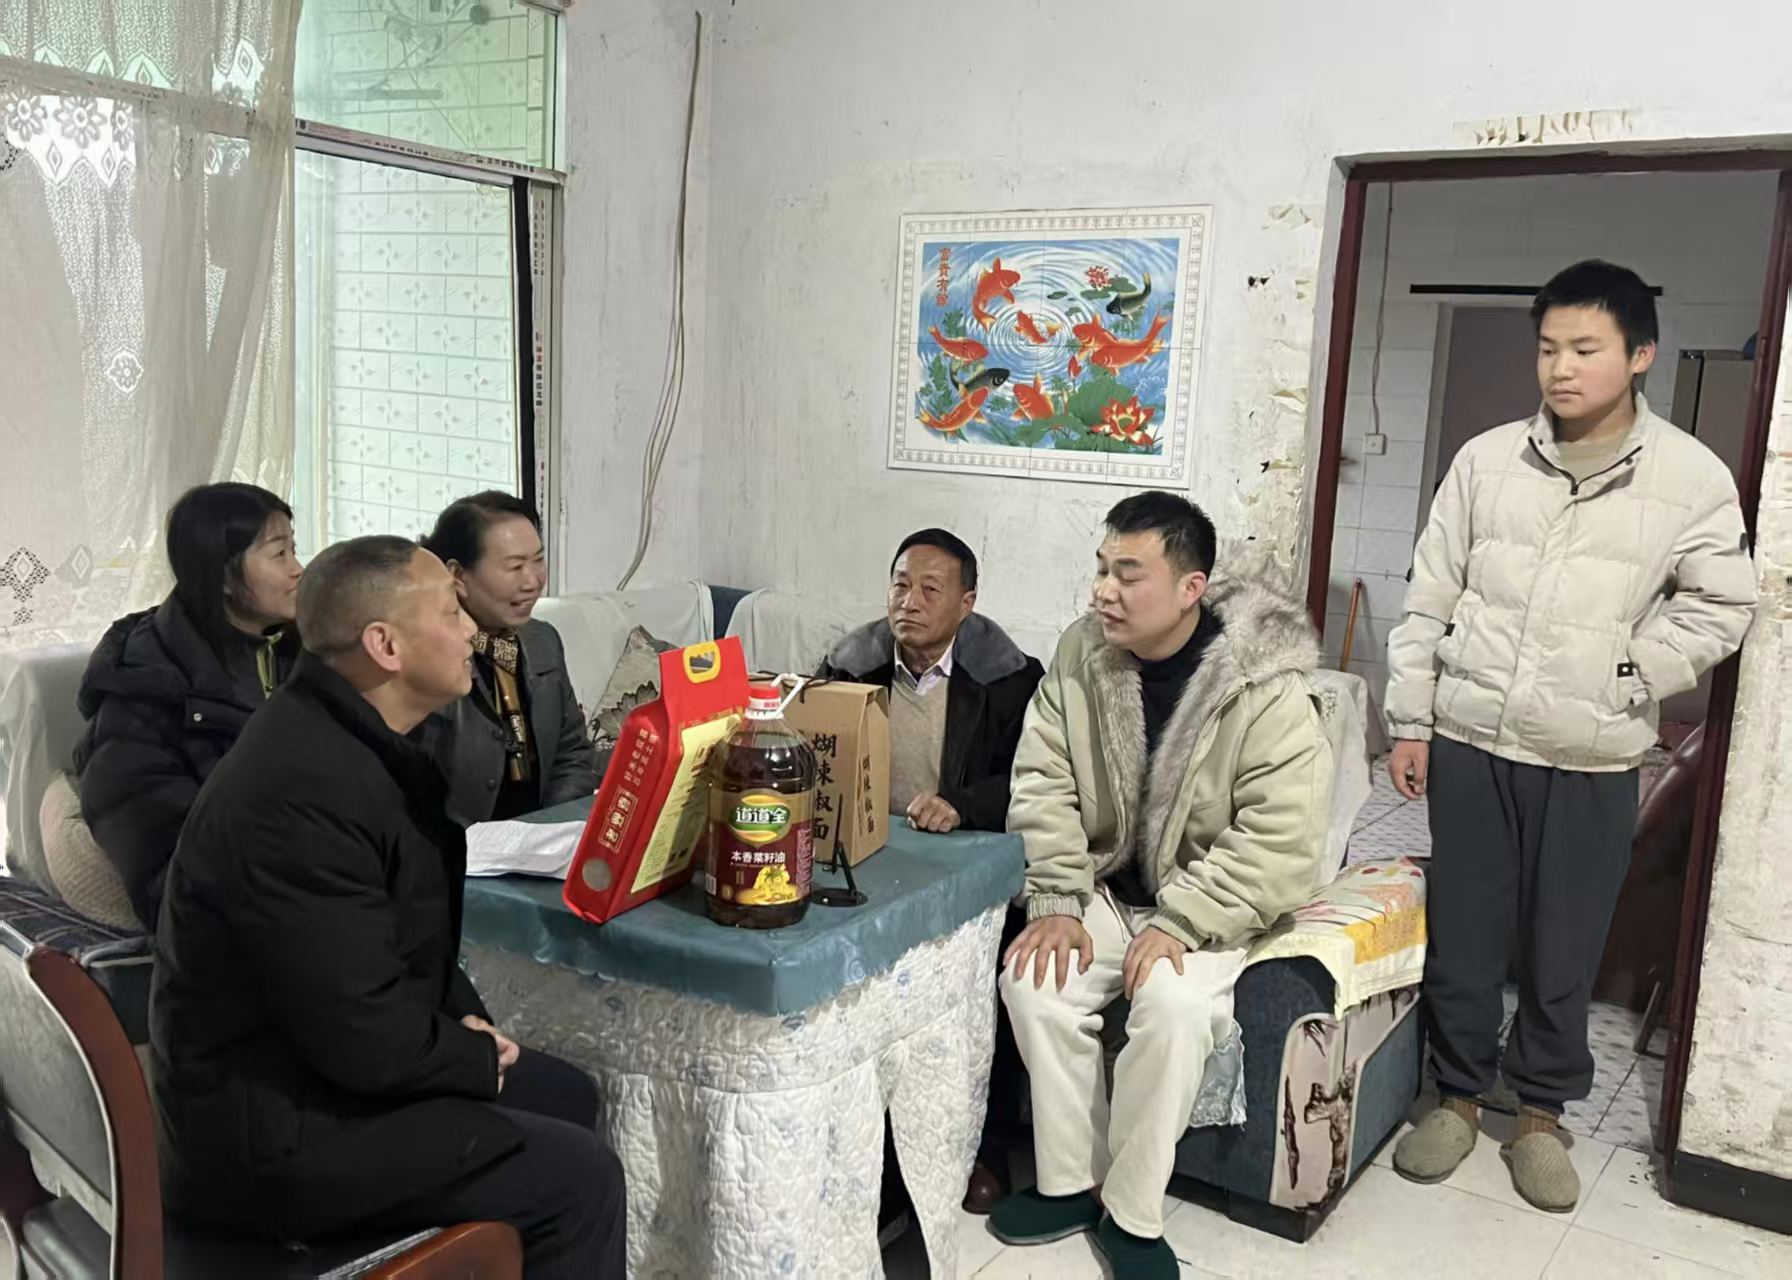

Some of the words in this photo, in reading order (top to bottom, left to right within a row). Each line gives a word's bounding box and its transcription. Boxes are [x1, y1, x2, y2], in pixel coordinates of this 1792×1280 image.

[735, 806, 787, 824] 道道全
[731, 851, 786, 864] 本香菜籽油
